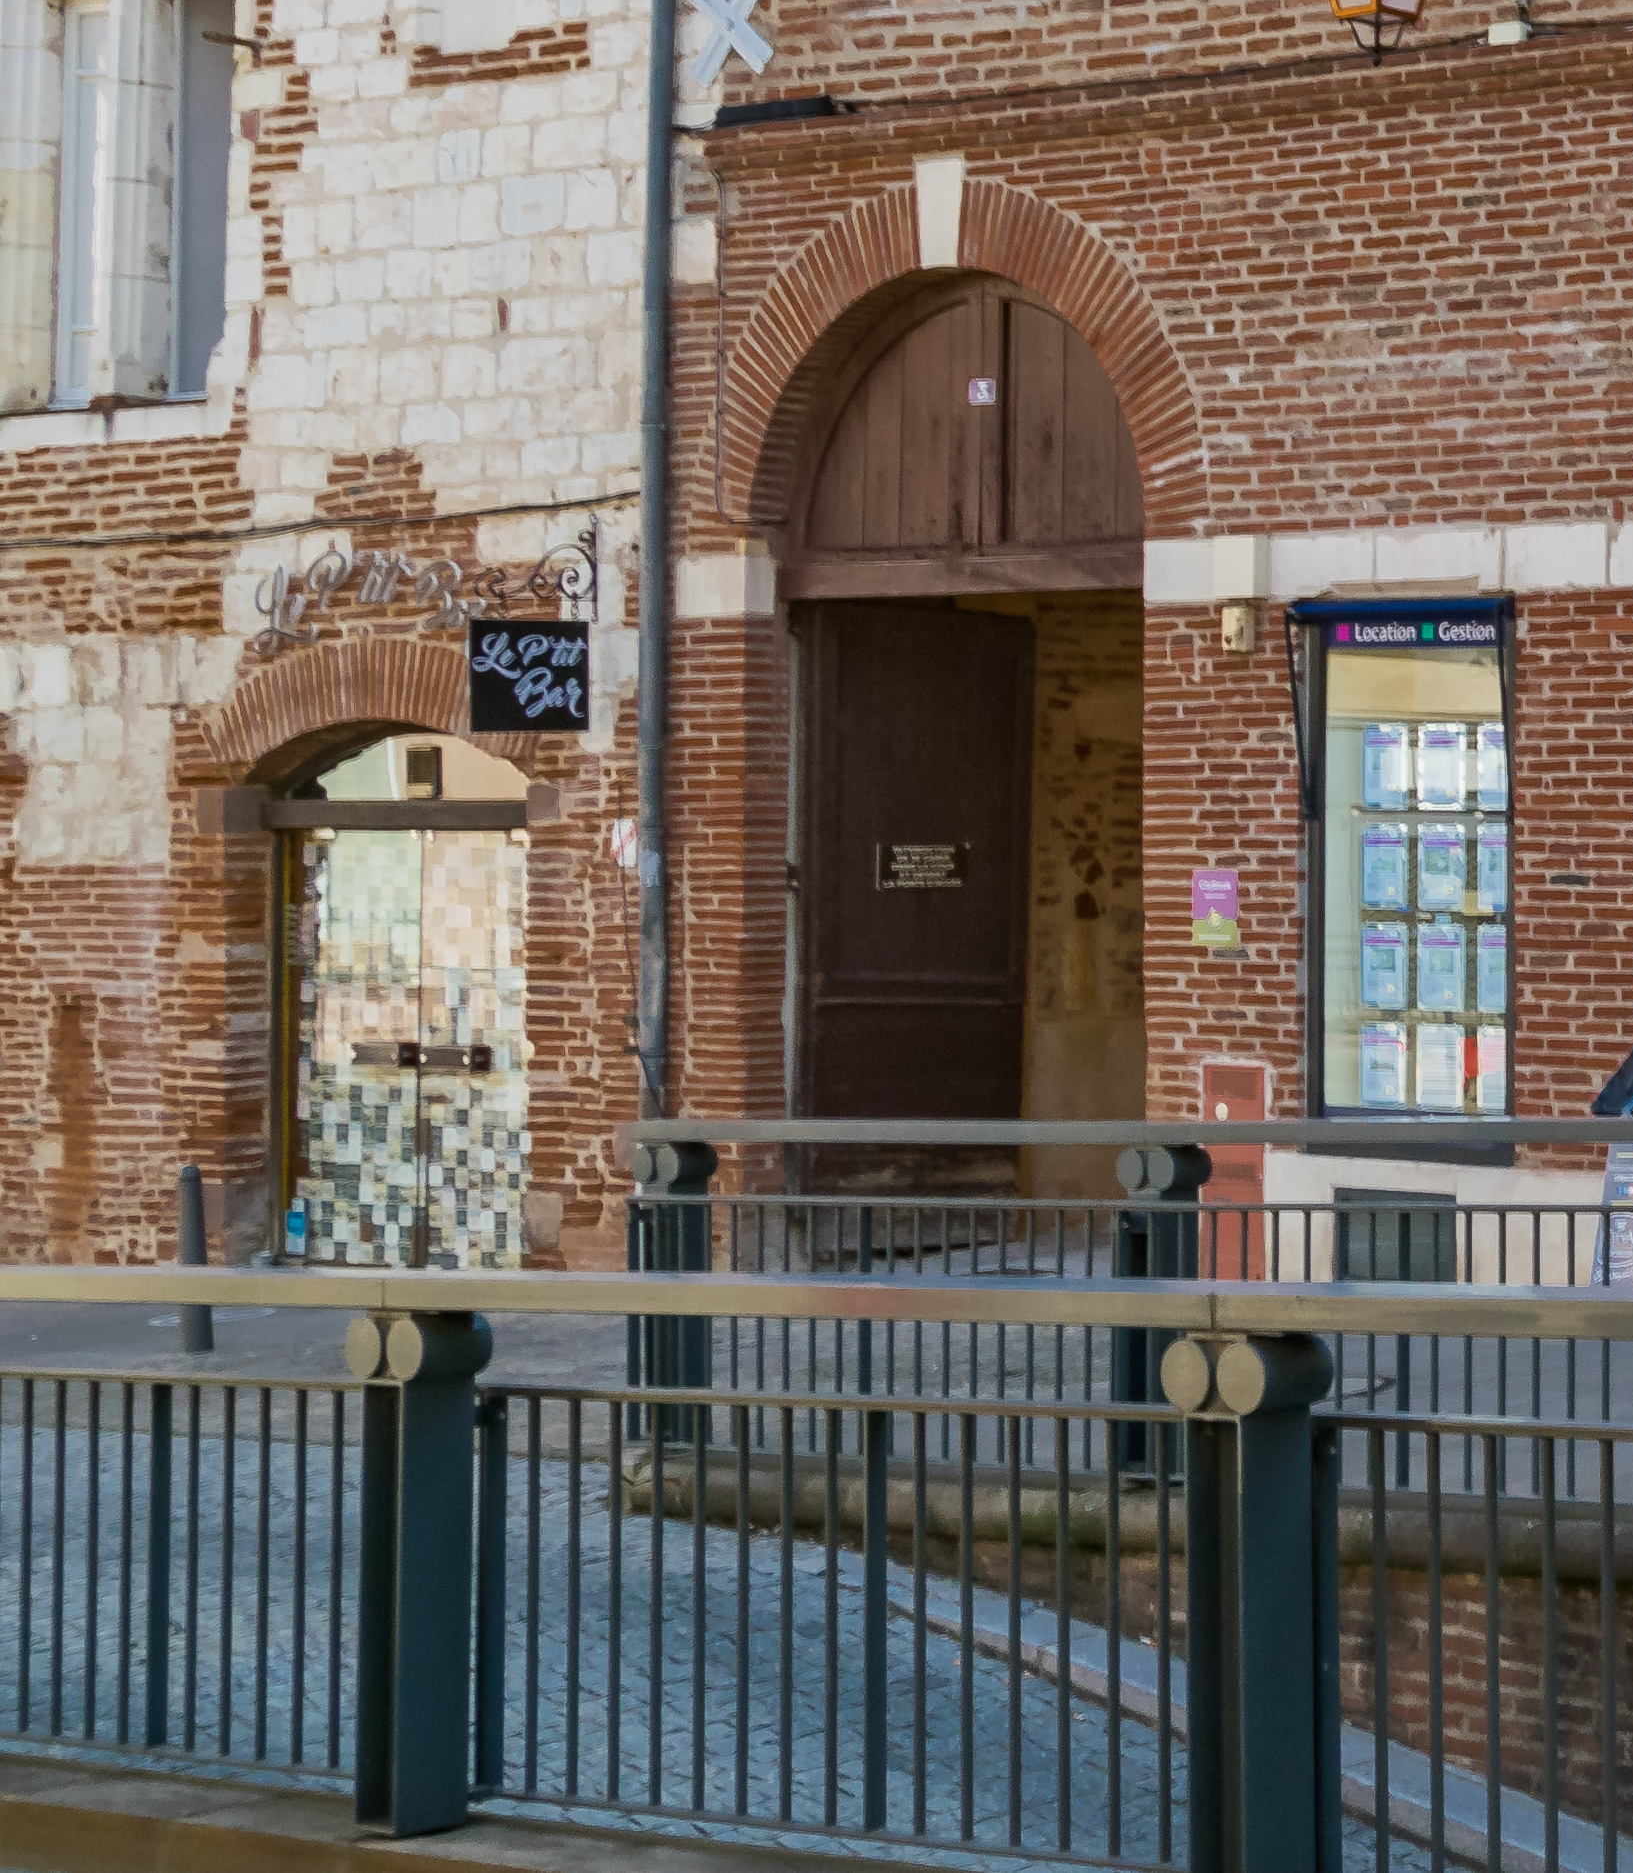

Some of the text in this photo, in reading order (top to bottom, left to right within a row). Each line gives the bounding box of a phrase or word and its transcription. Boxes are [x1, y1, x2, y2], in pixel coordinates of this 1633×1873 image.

[977, 381, 988, 401] 3
[1354, 620, 1495, 642] Location Gestion
[472, 631, 522, 679] Le
[513, 667, 585, 718] Bar
